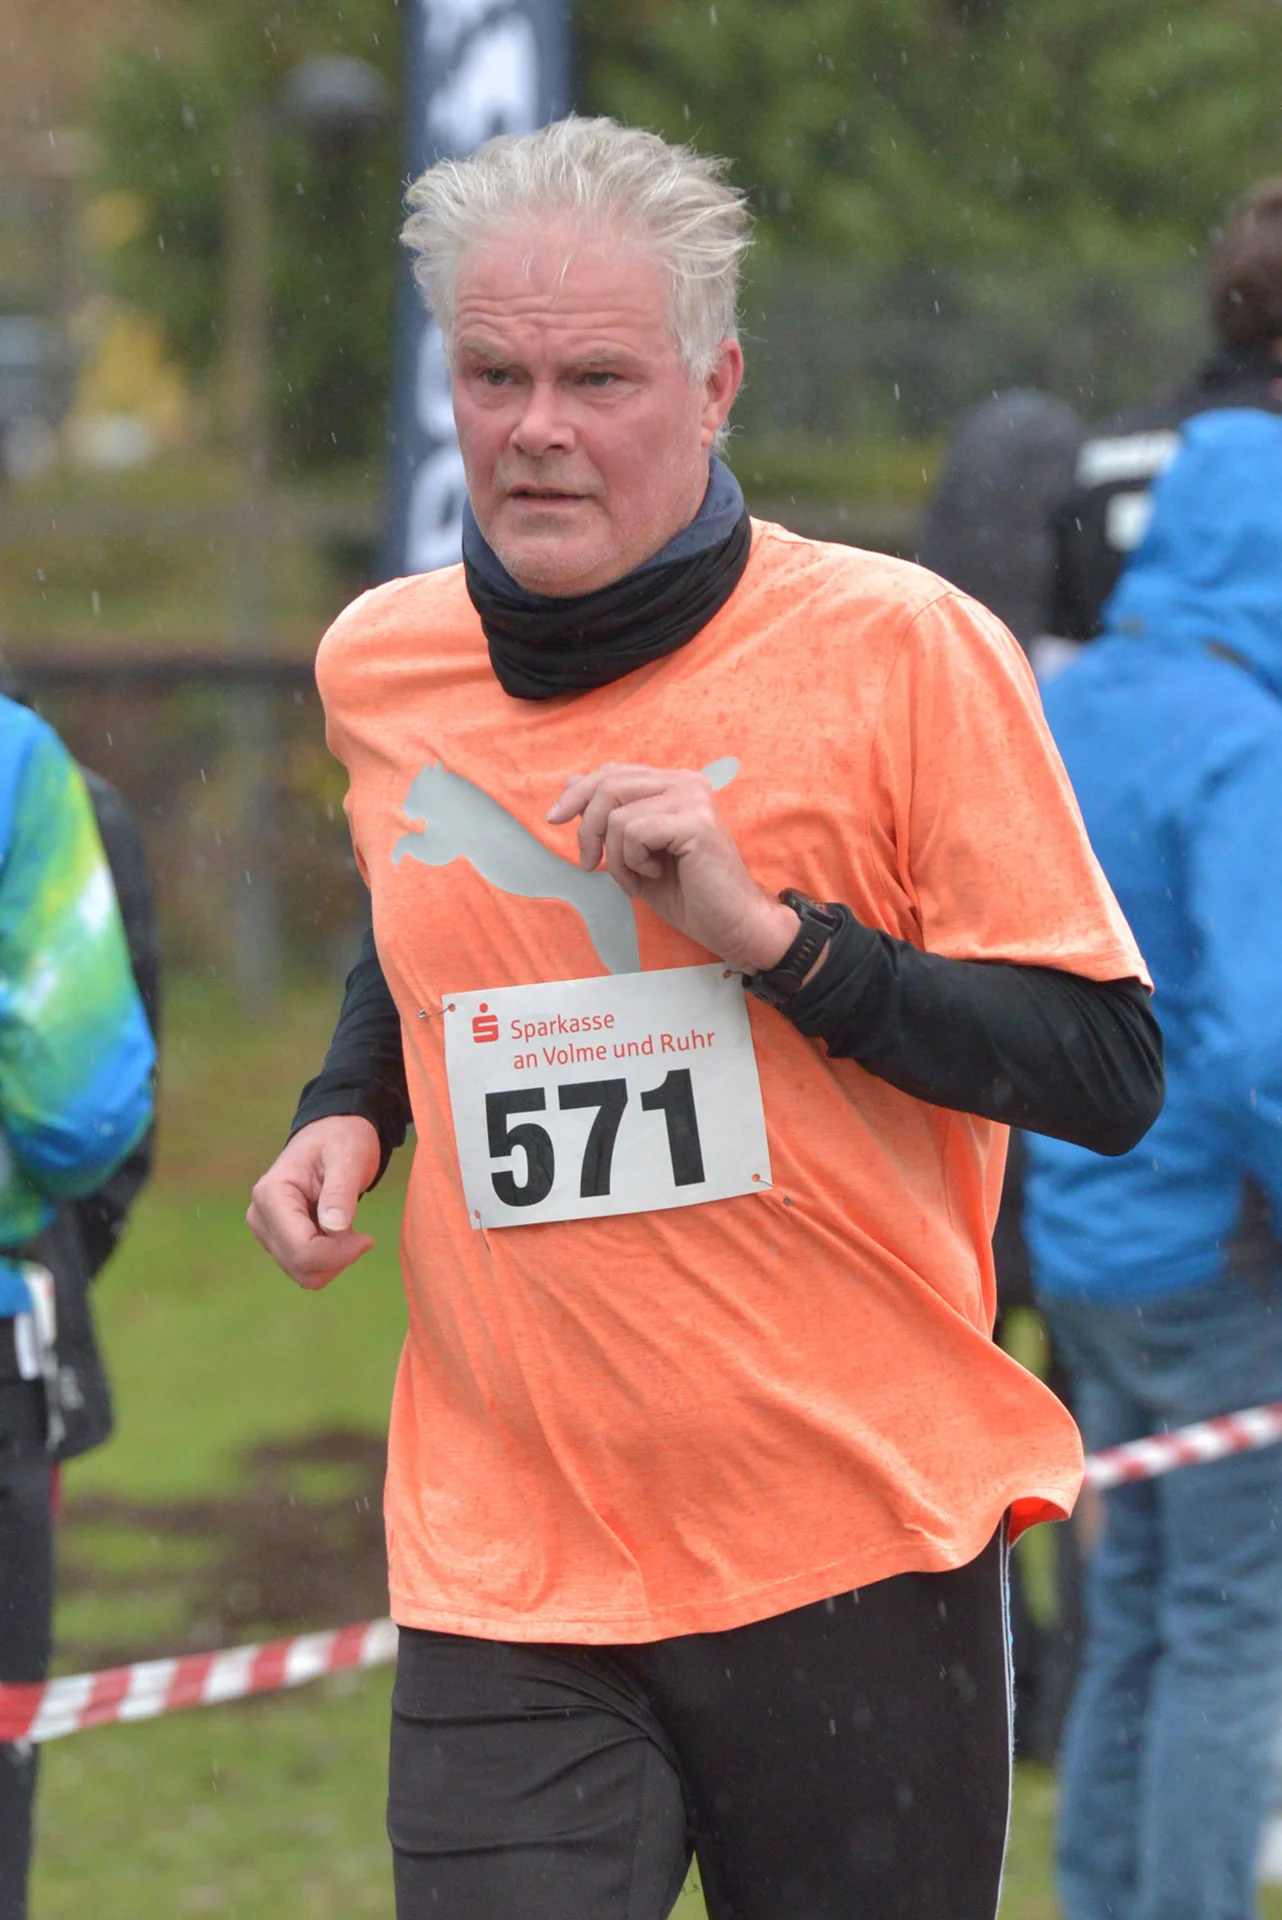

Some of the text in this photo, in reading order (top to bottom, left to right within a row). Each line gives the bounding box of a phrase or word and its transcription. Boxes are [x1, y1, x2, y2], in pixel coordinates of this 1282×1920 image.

[510, 1013, 616, 1043] Sparkasse
[513, 1029, 716, 1070] an Volme und Ruhr
[485, 1068, 706, 1208] 571
